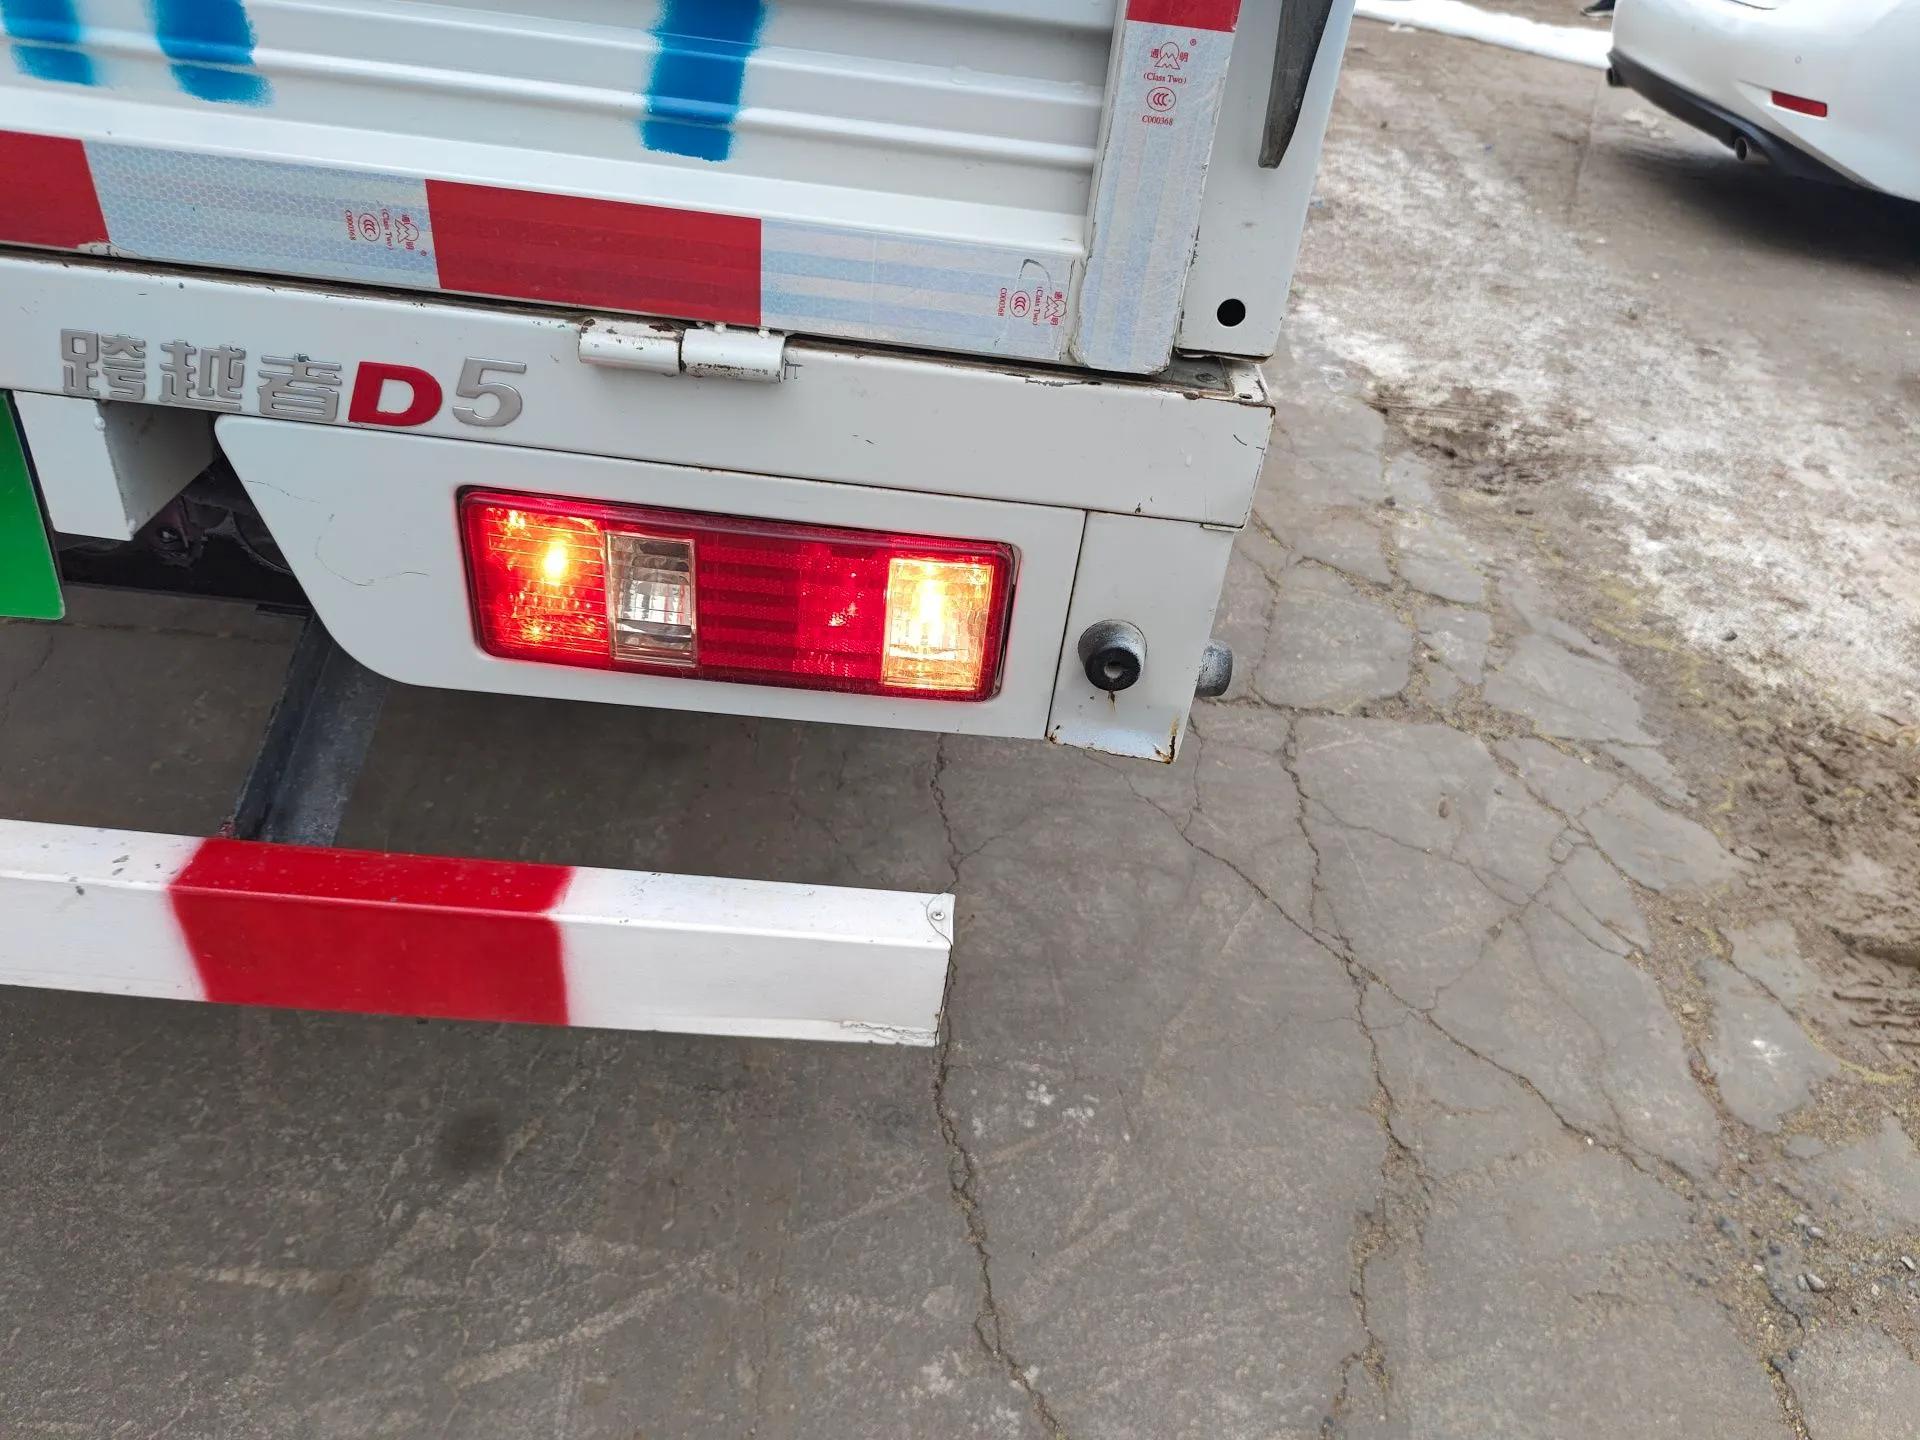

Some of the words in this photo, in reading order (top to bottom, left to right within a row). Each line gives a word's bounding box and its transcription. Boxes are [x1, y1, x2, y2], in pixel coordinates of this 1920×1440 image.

[1143, 72, 1166, 82] (Class
[1168, 74, 1187, 84] Two)
[1142, 114, 1173, 126] C000368
